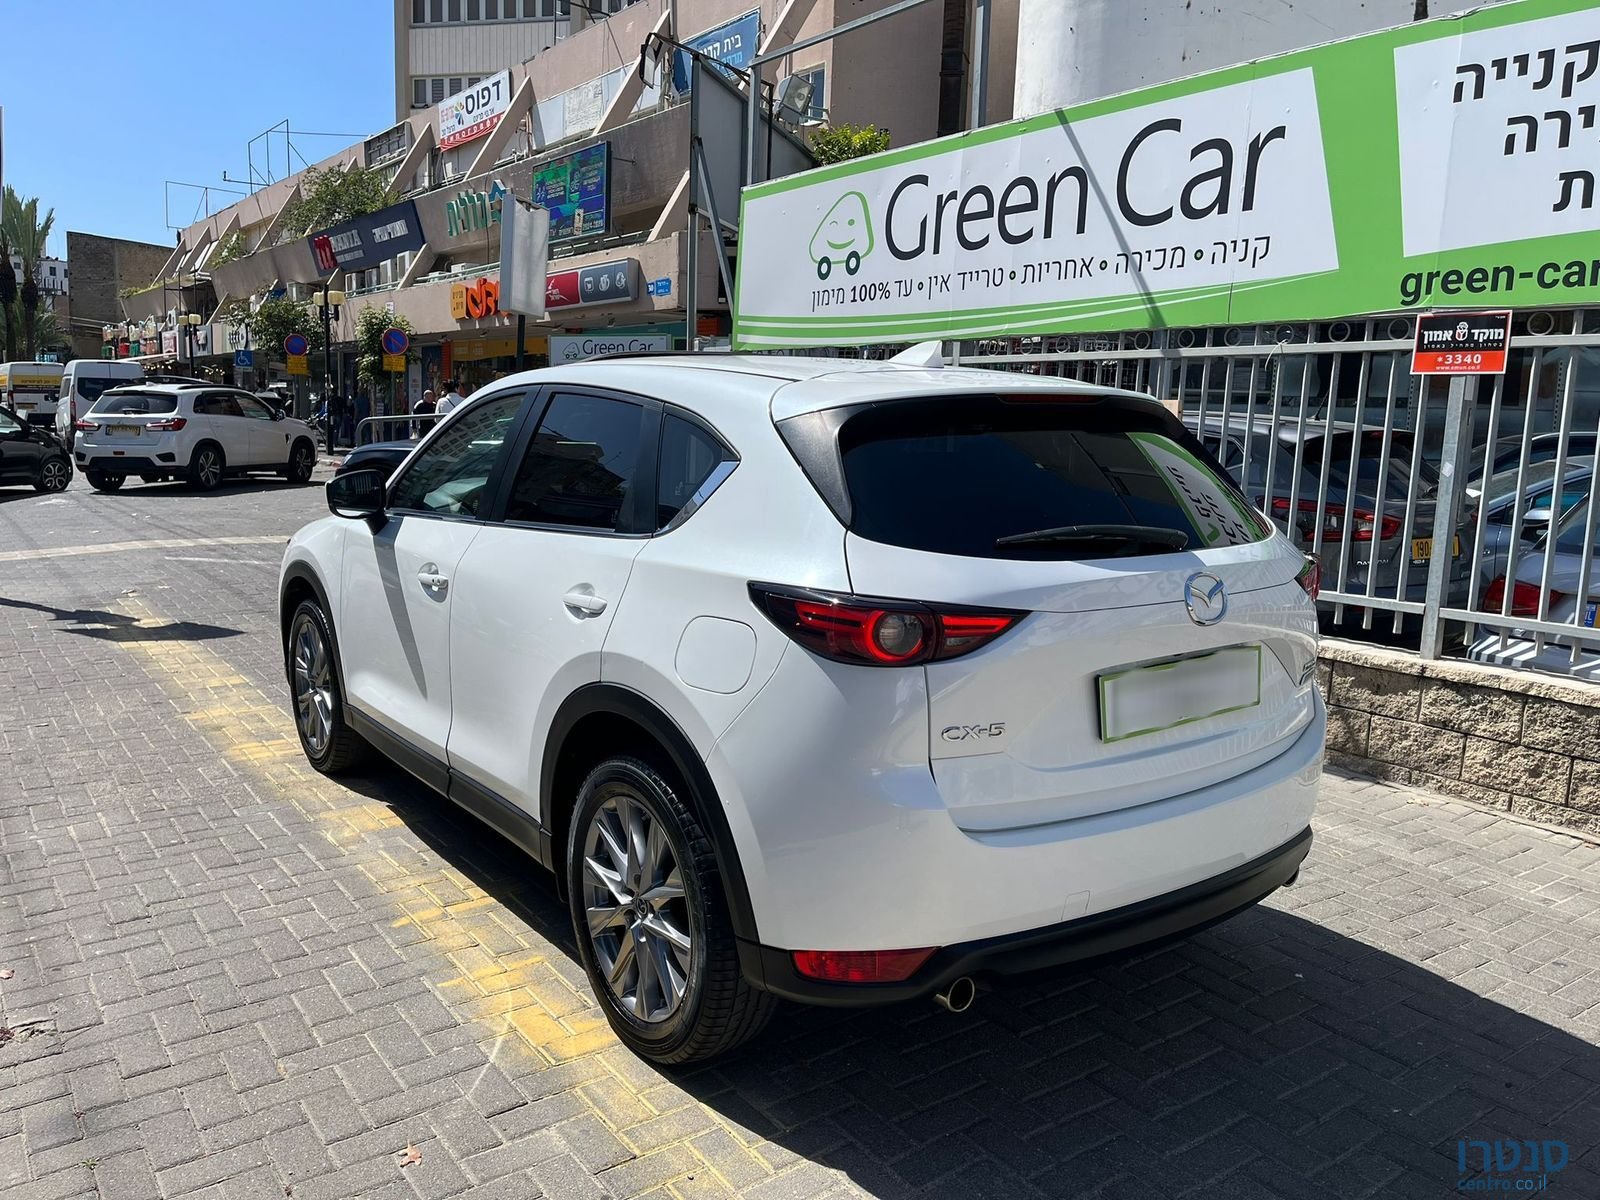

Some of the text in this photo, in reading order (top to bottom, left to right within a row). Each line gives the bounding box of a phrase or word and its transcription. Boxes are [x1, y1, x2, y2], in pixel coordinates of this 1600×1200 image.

[723, 34, 742, 53] בית
[1453, 40, 1600, 103] קנייה
[465, 79, 501, 115] דפוס
[1504, 104, 1600, 156] ירה
[885, 117, 1286, 262] Green Car
[811, 235, 1272, 313] קניה מכירה אחריות טרייד אין עד 100% מימון
[582, 339, 653, 355] Green Car
[1423, 328, 1504, 344] מוקד אמון
[941, 722, 1006, 742] CX-5
